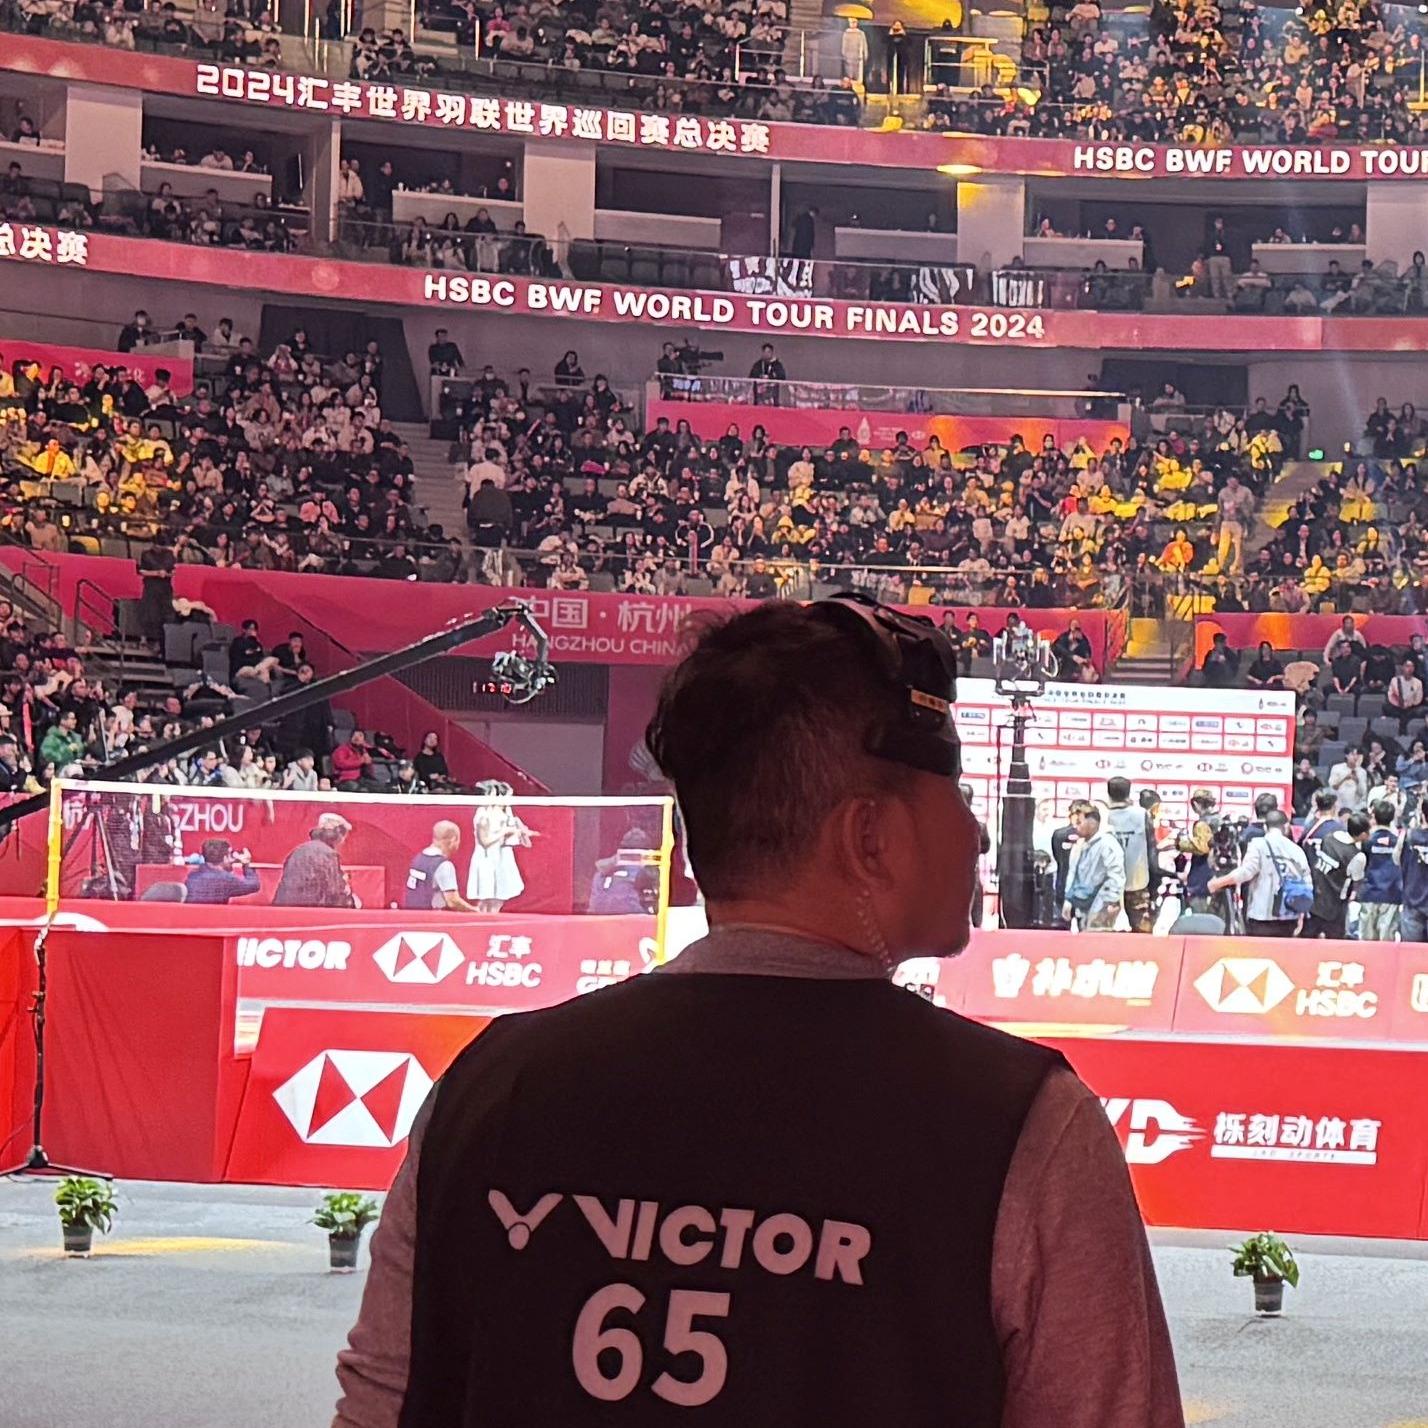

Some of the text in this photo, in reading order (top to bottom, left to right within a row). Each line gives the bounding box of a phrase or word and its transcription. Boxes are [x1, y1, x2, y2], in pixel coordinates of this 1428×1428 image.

[197, 64, 770, 153] 2024汇丰世界羽联世界巡回赛总决赛
[1074, 146, 1155, 171] HSBC
[1166, 148, 1232, 172] BWF
[1242, 150, 1350, 174] WORLD
[424, 275, 1045, 338] HSBC BWF WORLD TOUR FINALS 2024
[466, 961, 543, 988] HSBC
[1296, 989, 1378, 1018] HSBC
[571, 1194, 872, 1286] VICTOR
[572, 1283, 731, 1407] 65
